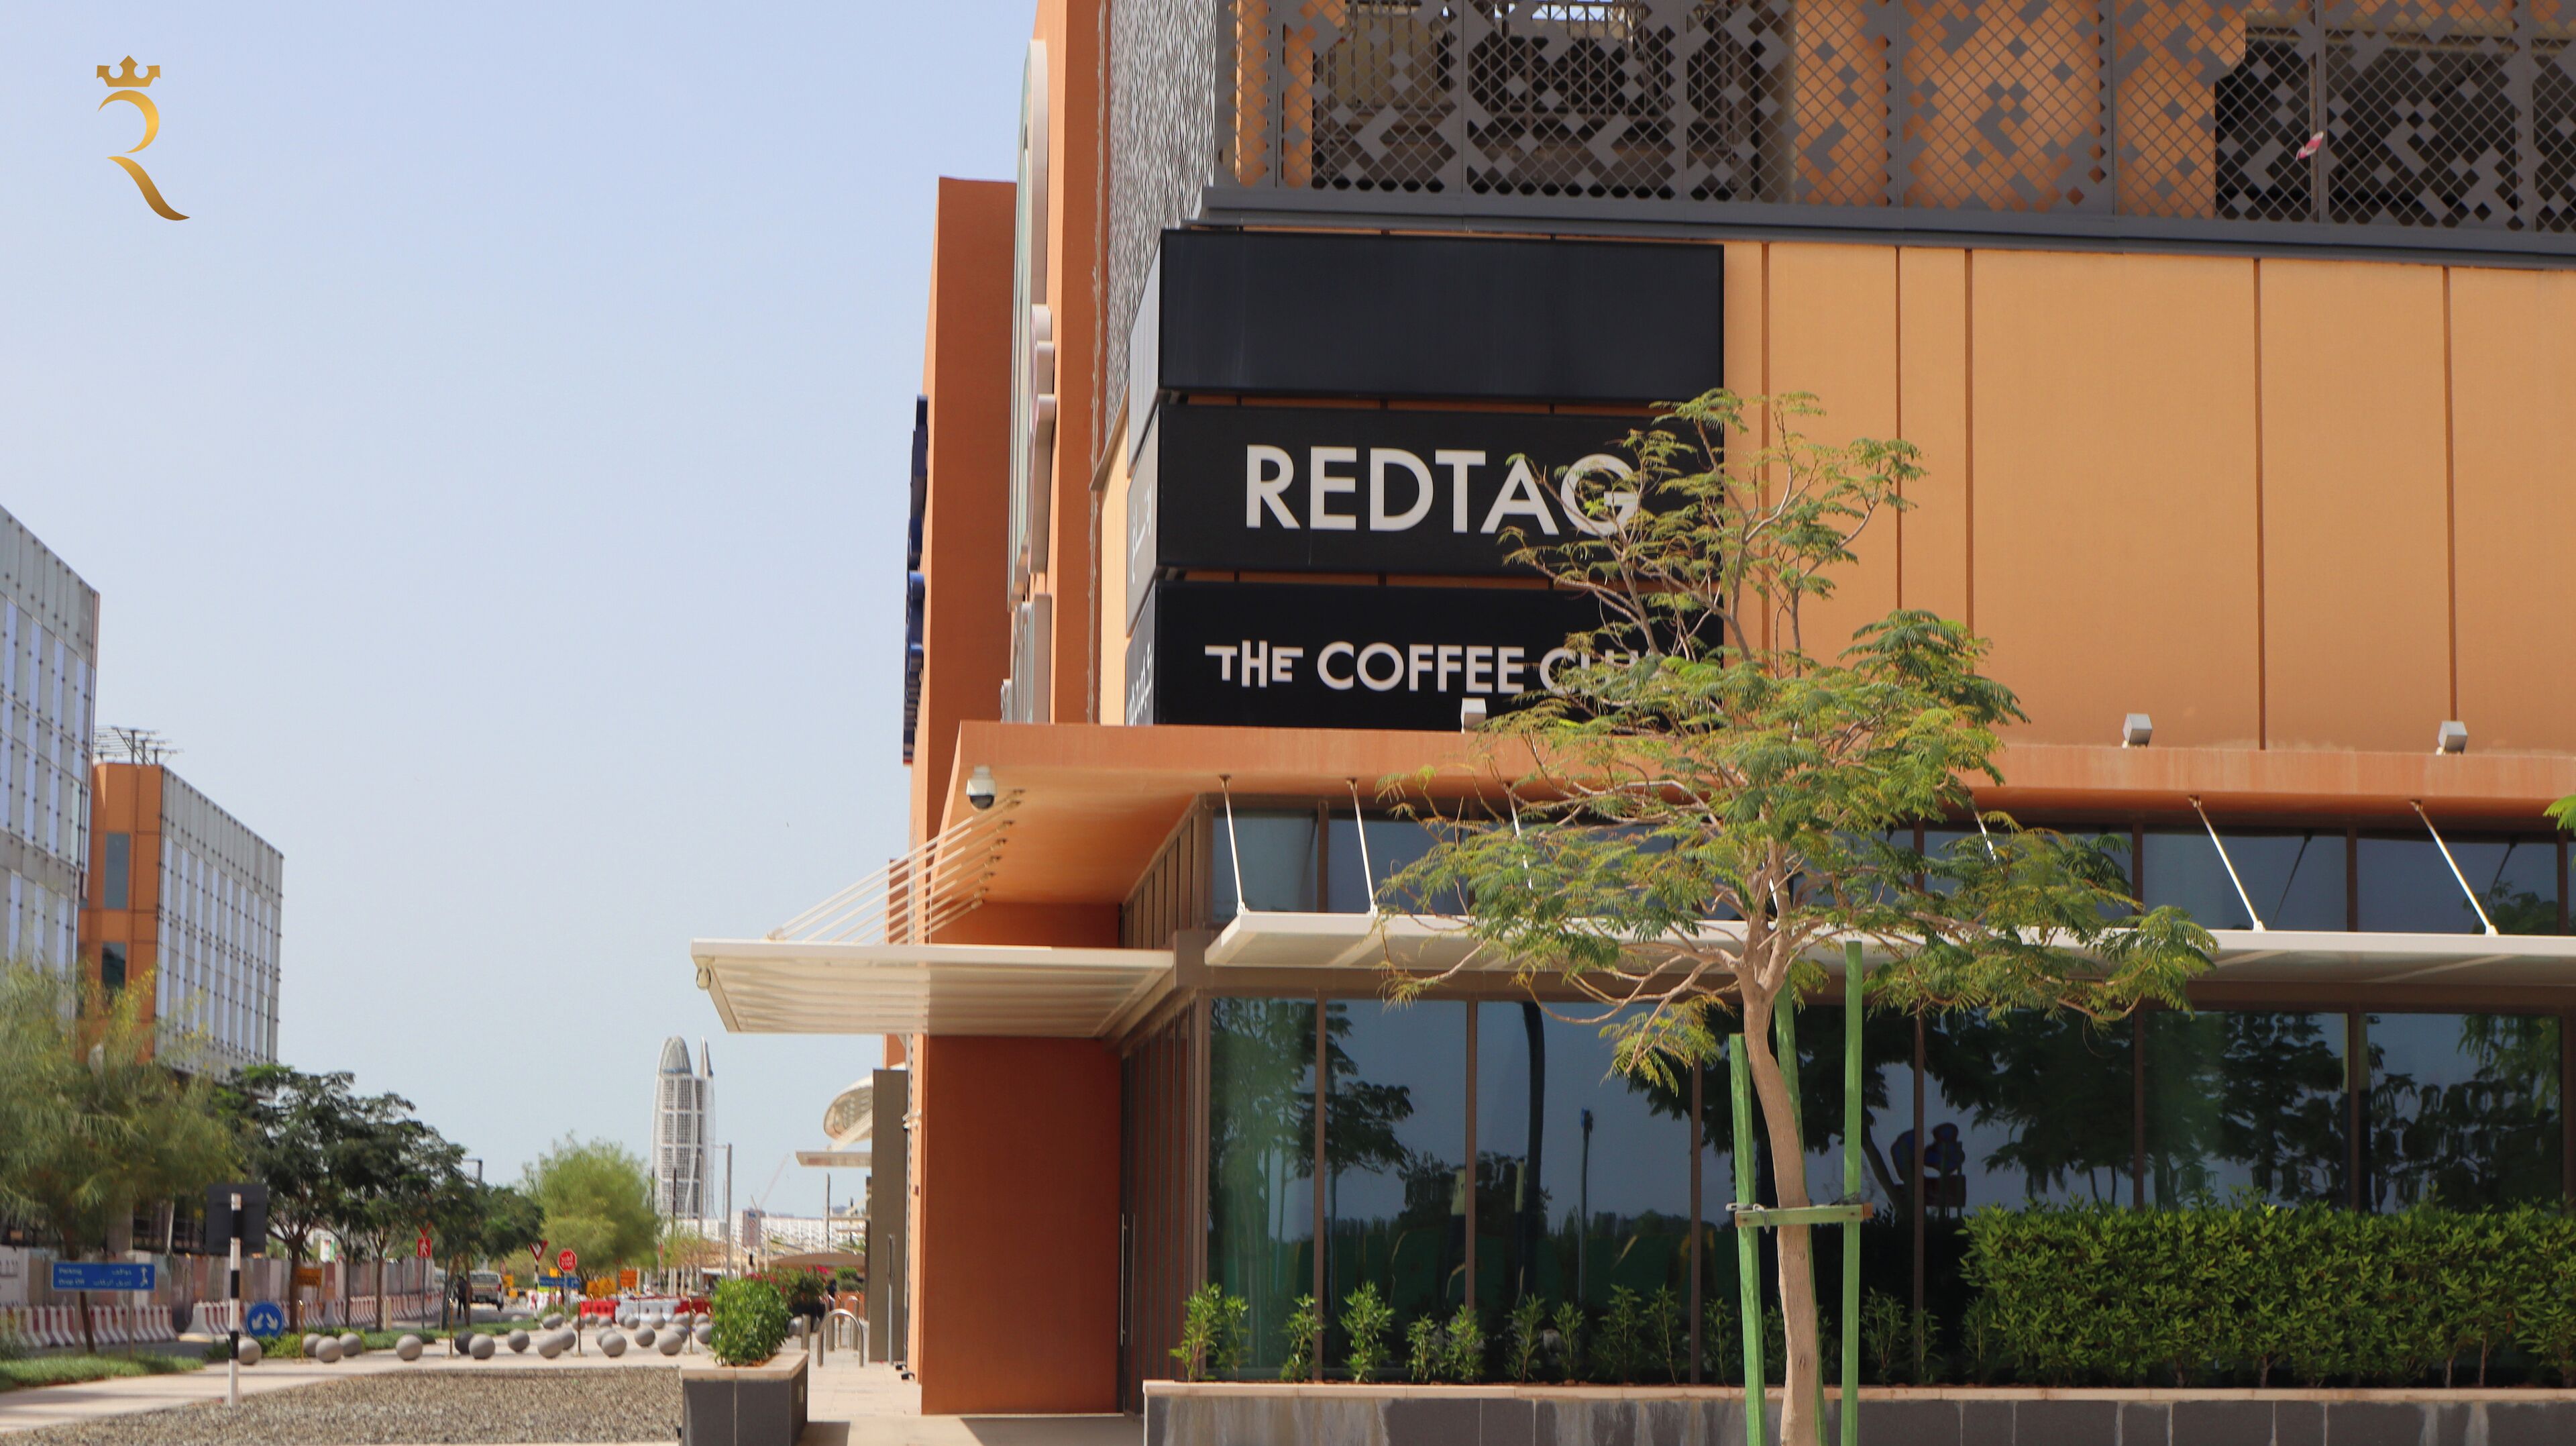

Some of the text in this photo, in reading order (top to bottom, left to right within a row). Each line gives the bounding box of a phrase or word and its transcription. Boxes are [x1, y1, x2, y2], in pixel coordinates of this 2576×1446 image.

[1246, 444, 1640, 537] REDTAG
[1205, 639, 1303, 687] THE
[1317, 641, 1525, 693] COFFEE
